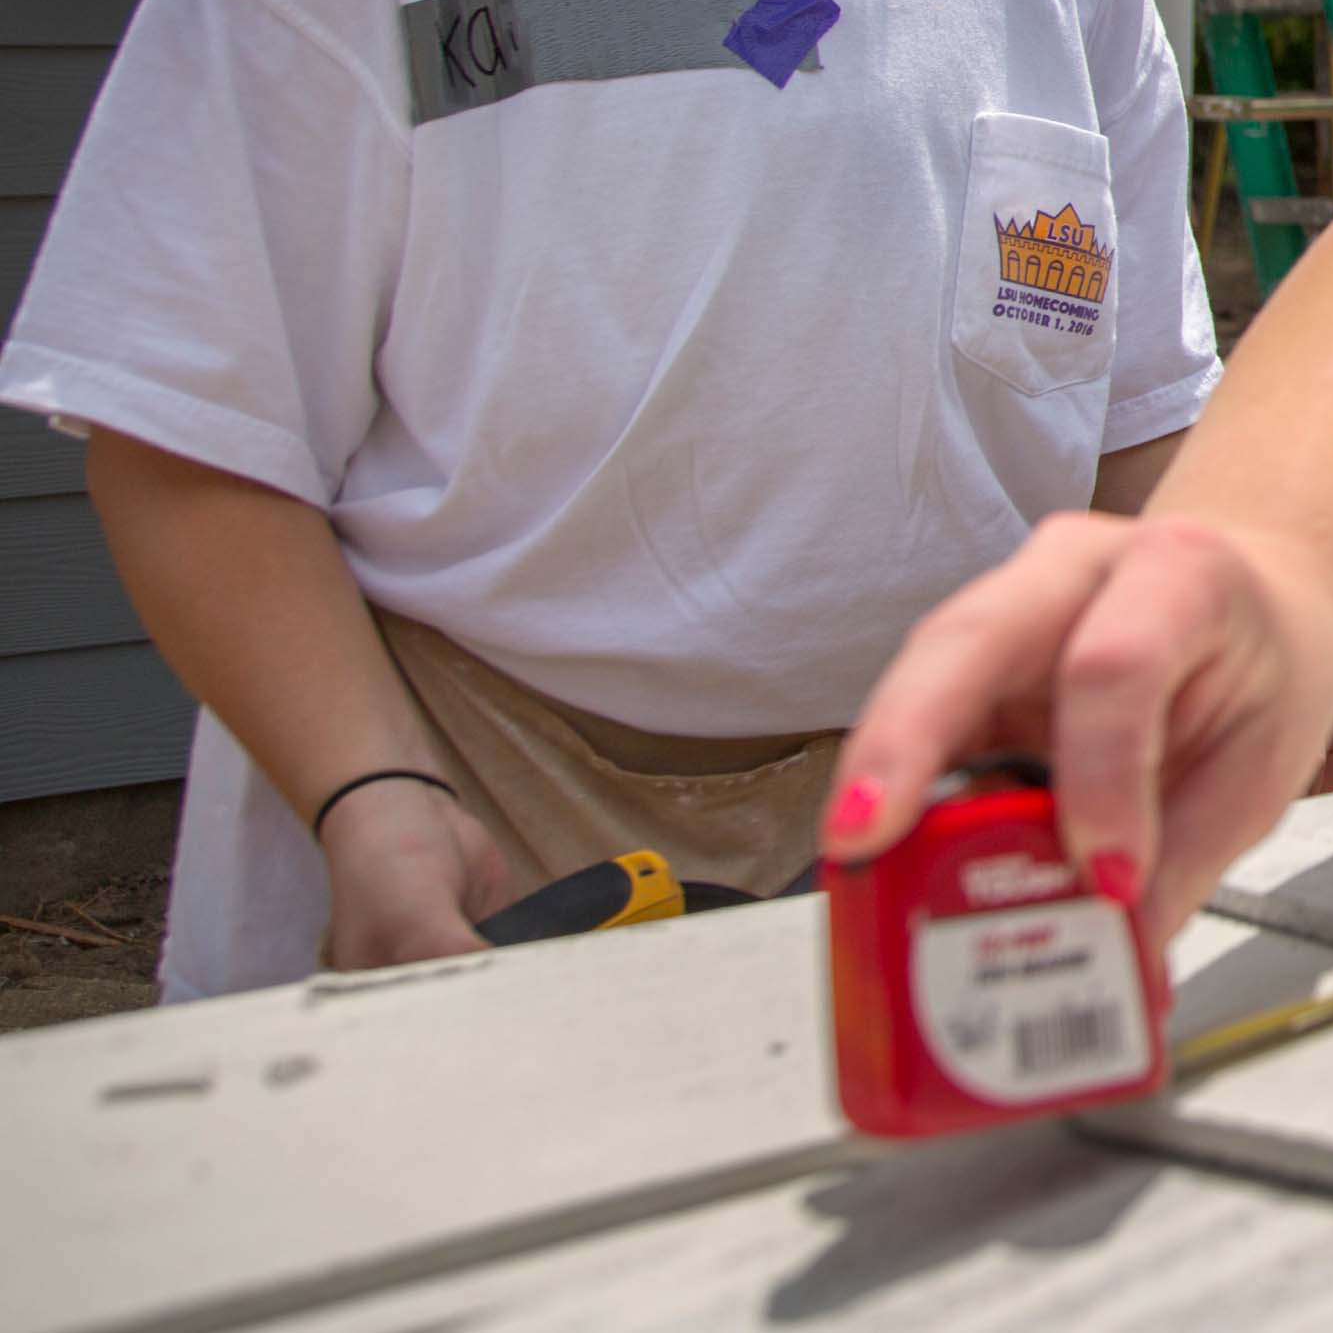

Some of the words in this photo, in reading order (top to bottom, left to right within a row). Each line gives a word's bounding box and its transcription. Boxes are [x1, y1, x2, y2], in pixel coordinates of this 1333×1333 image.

[1047, 222, 1084, 246] LSU
[993, 303, 1051, 328] OCTOBER
[1067, 319, 1095, 336] 2016
[997, 286, 1018, 302] LSU
[1019, 290, 1100, 321] HOMECOMING
